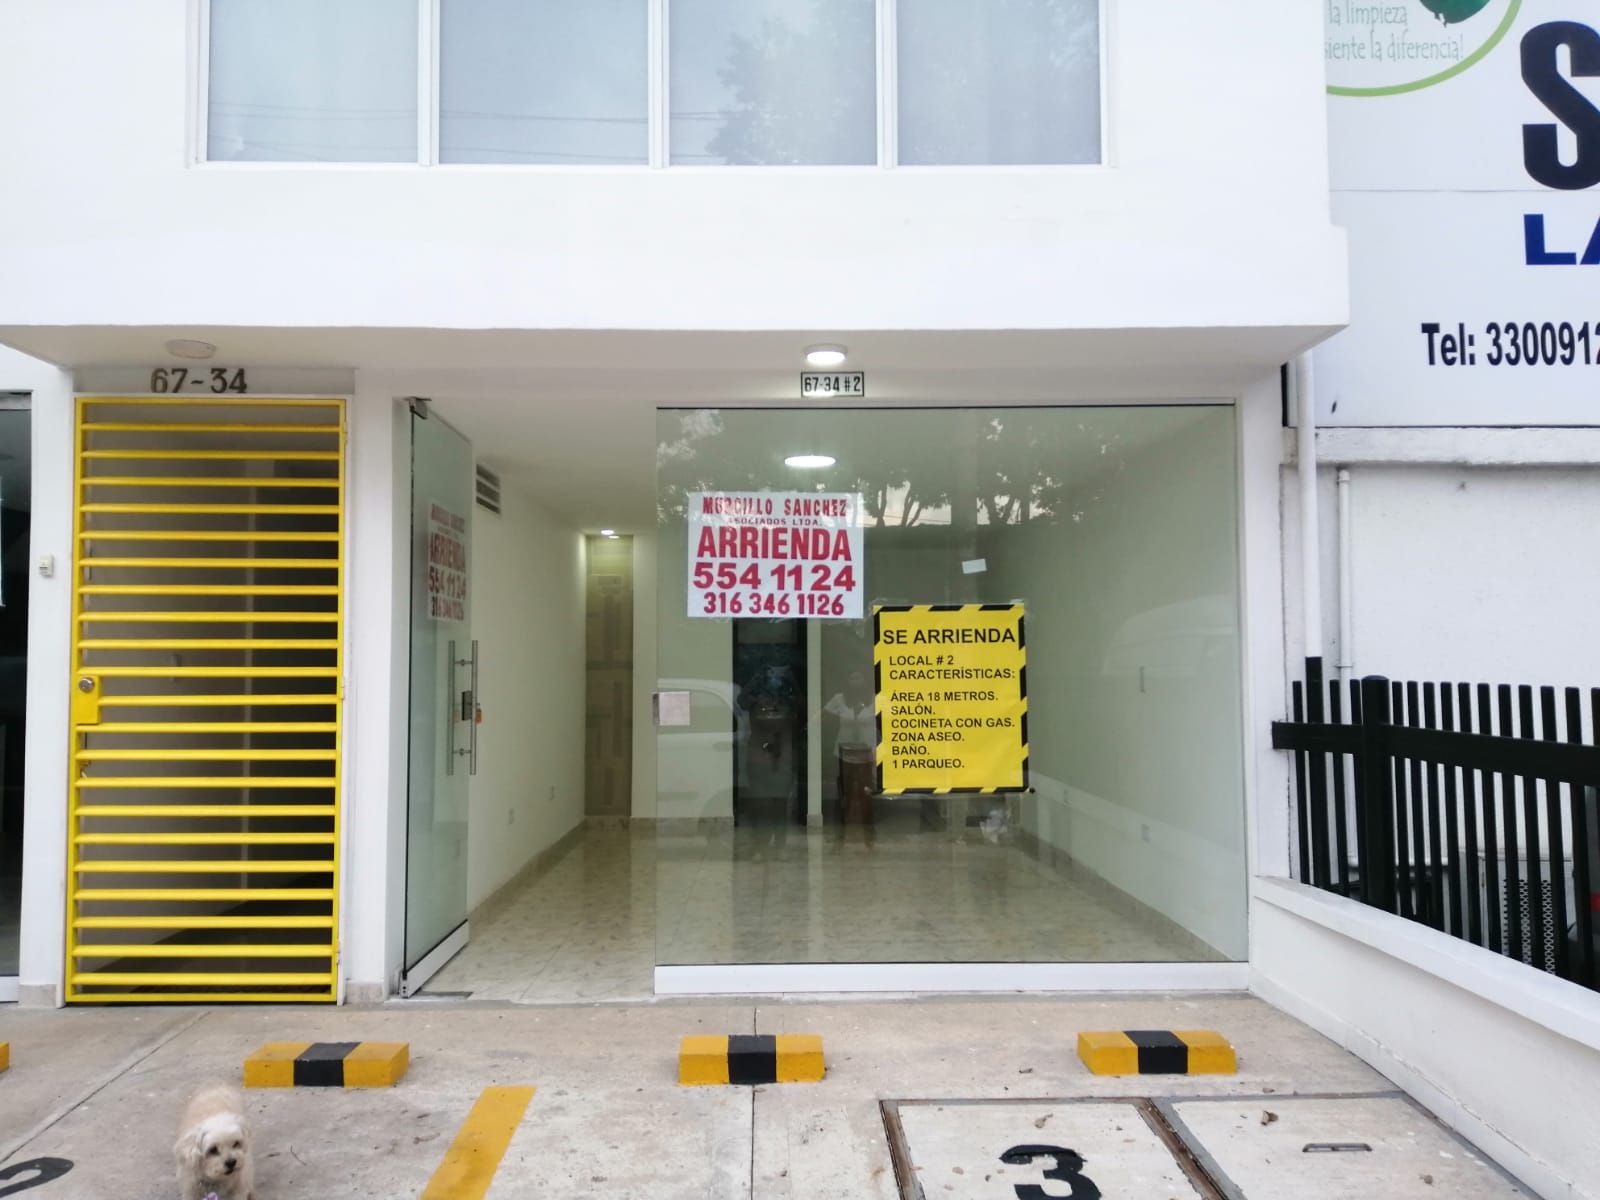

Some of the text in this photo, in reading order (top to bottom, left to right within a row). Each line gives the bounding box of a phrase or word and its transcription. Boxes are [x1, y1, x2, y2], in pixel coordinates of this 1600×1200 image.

[1328, 0, 1408, 33] la limpieza
[1370, 31, 1383, 61] la
[1387, 28, 1464, 61] diferencia!
[1520, 21, 1600, 190] S
[1421, 322, 1476, 366] Tel:
[150, 368, 248, 394] 67-34
[804, 376, 840, 392] 67-34
[784, 498, 848, 517] SANCHEZ
[727, 517, 787, 526] SOCIADOS
[697, 526, 852, 561] ARRIENDA
[693, 561, 762, 590] 554
[703, 591, 845, 616] 316 346 1126
[883, 628, 1016, 645] SE ARRIENDA
[889, 655, 933, 666] LOCAL
[889, 667, 1016, 680] CARACTERÍSTICAS:
[890, 689, 999, 702] ÁREA 18 METROS.
[890, 703, 936, 715] SALÓN.
[891, 717, 1015, 729] COCINETA CON GAS.
[891, 731, 965, 742] ZONA ASEO.
[892, 743, 930, 756] BAÑO.
[892, 759, 965, 769] 1 PARQUEO.
[998, 1144, 1102, 1200] 3
